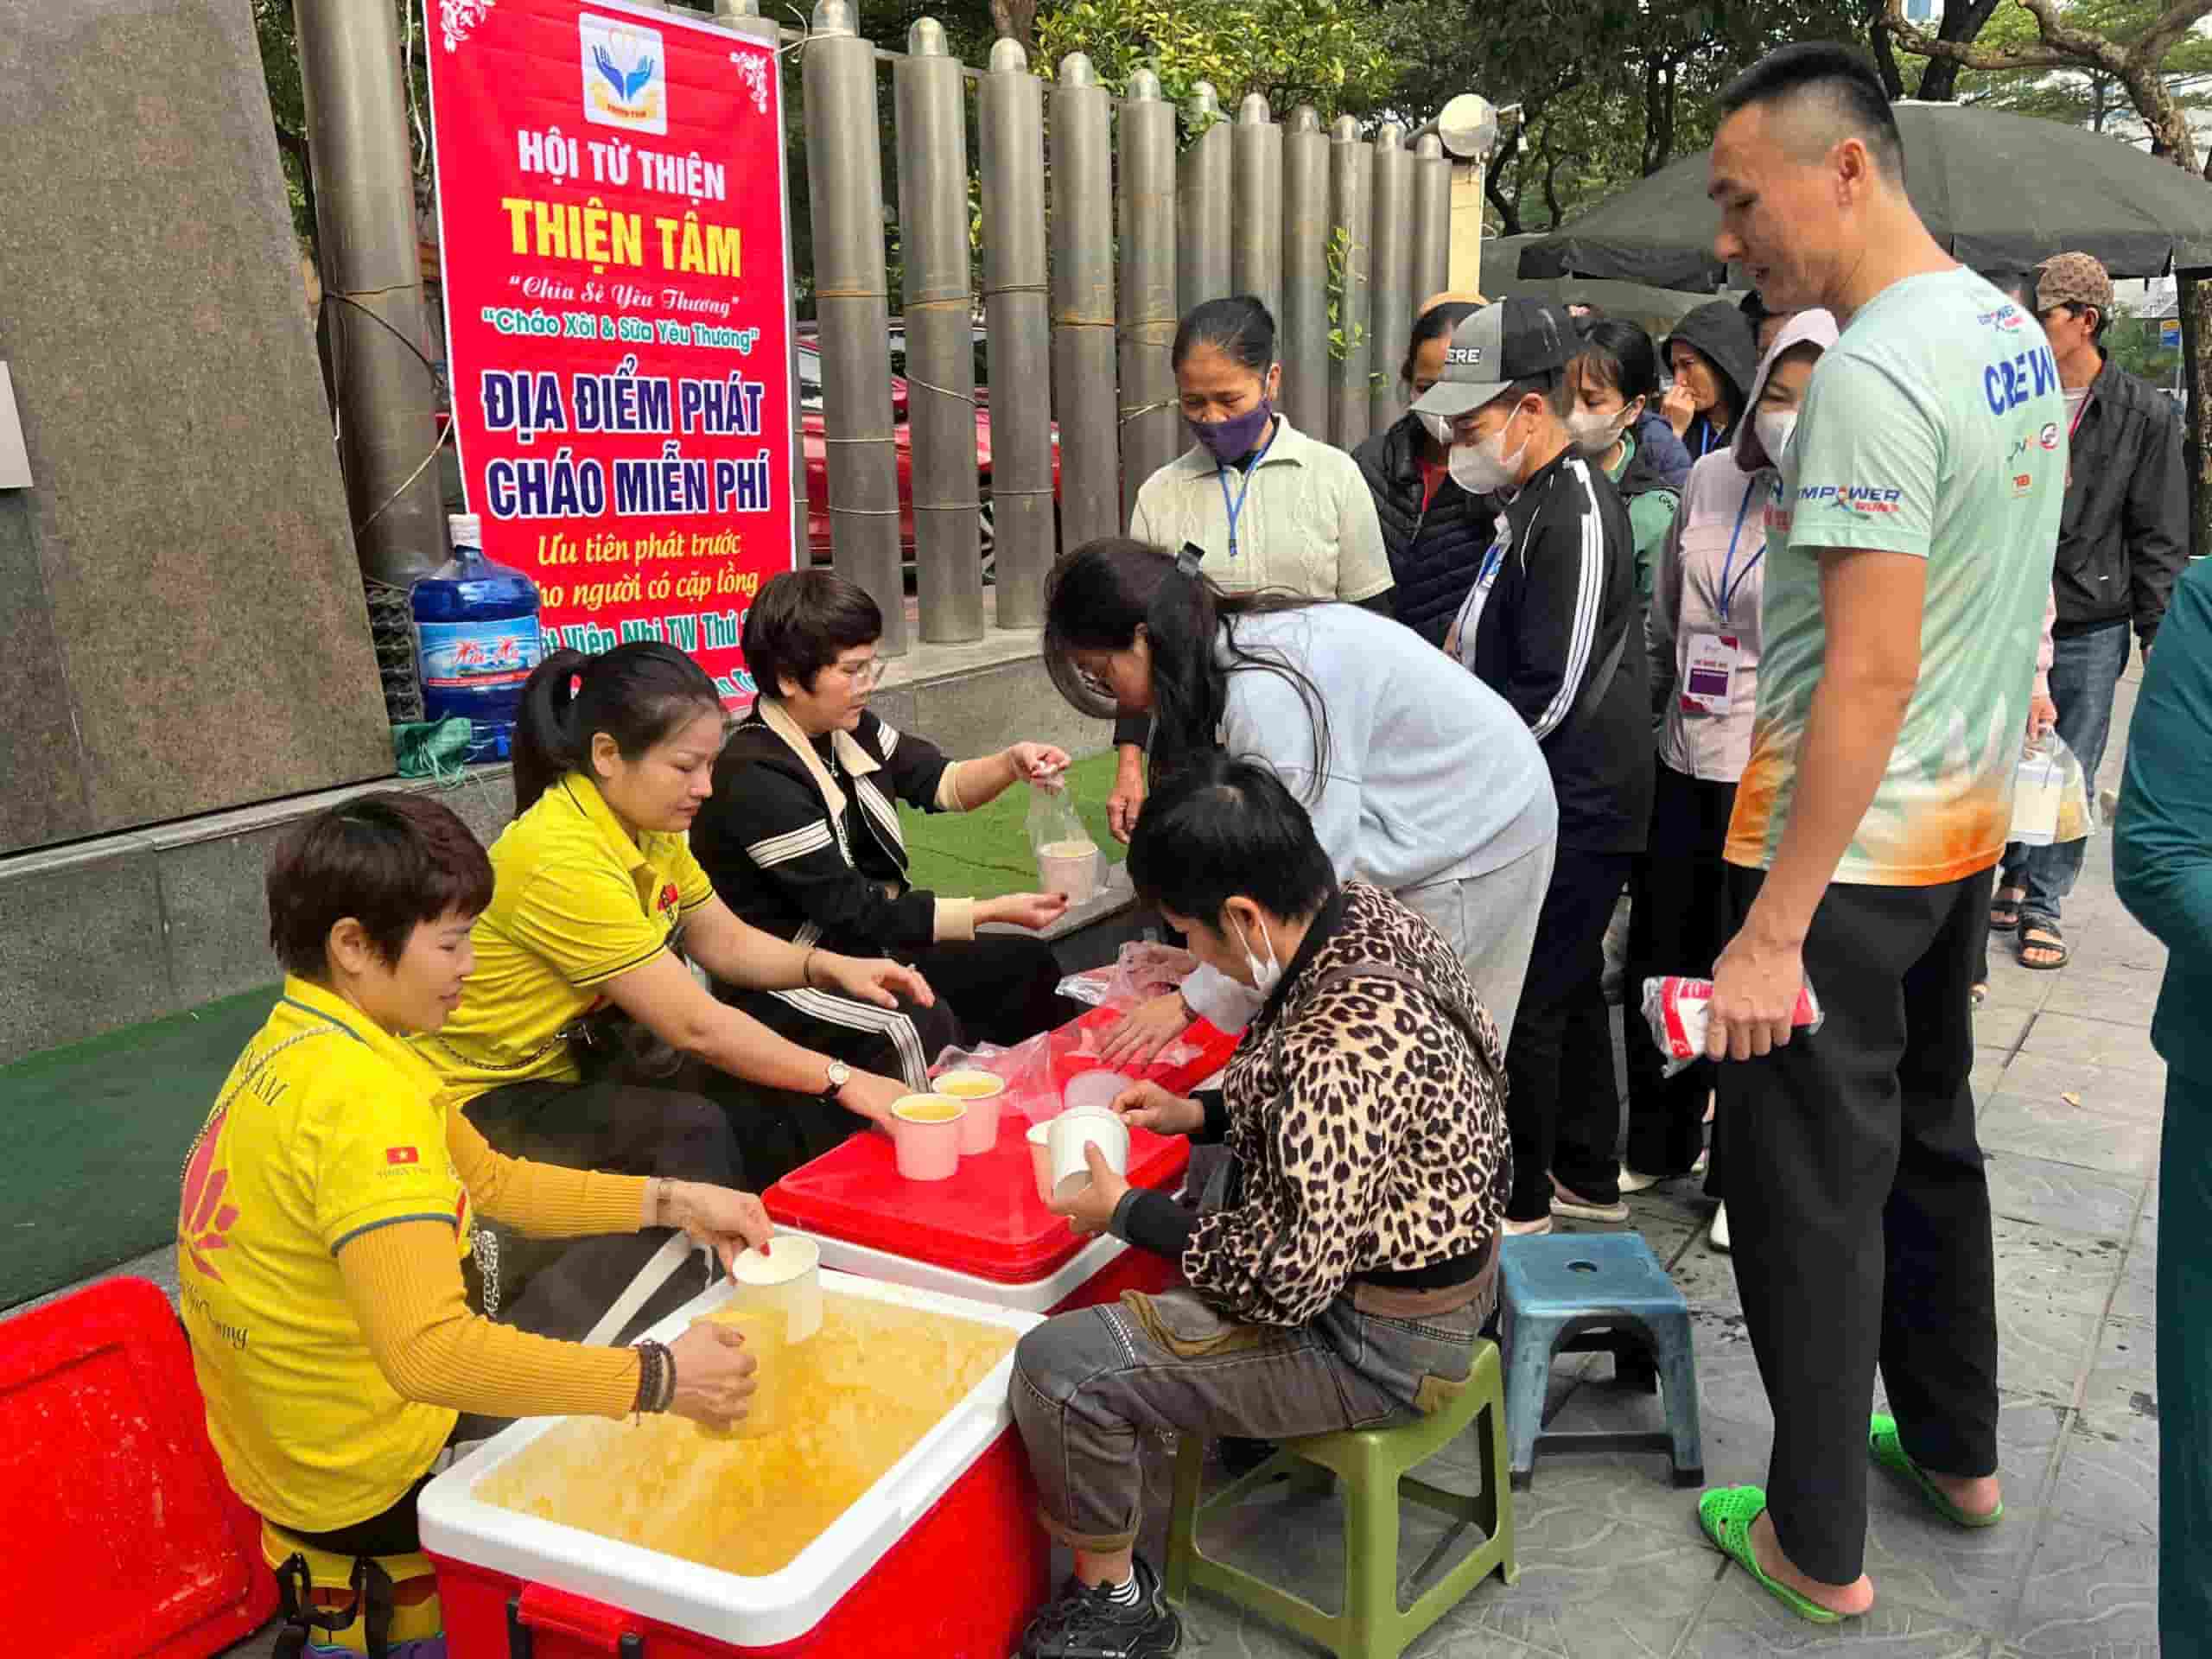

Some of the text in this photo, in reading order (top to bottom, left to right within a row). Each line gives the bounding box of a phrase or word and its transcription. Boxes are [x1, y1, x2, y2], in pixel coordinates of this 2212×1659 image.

[518, 126, 726, 206] HỘI TỪ THIỆN
[502, 196, 741, 278] THIỆN TÂM
[611, 283, 653, 308] Yêu
[564, 312, 596, 337] Xôi
[601, 315, 615, 338] &
[620, 315, 653, 341] Sữa
[657, 318, 691, 344] Yêu
[483, 353, 765, 442] ĐỊA ĐIỂM PHÁT
[1984, 346, 2056, 416] CREW
[486, 440, 771, 518] CHÁO MIỄN PHÍ
[538, 528, 741, 567] Ưu tiên phát trước
[534, 580, 564, 608] ho
[573, 570, 643, 611] người
[648, 570, 671, 600] có
[716, 561, 760, 598] lồng
[664, 614, 697, 652] TW
